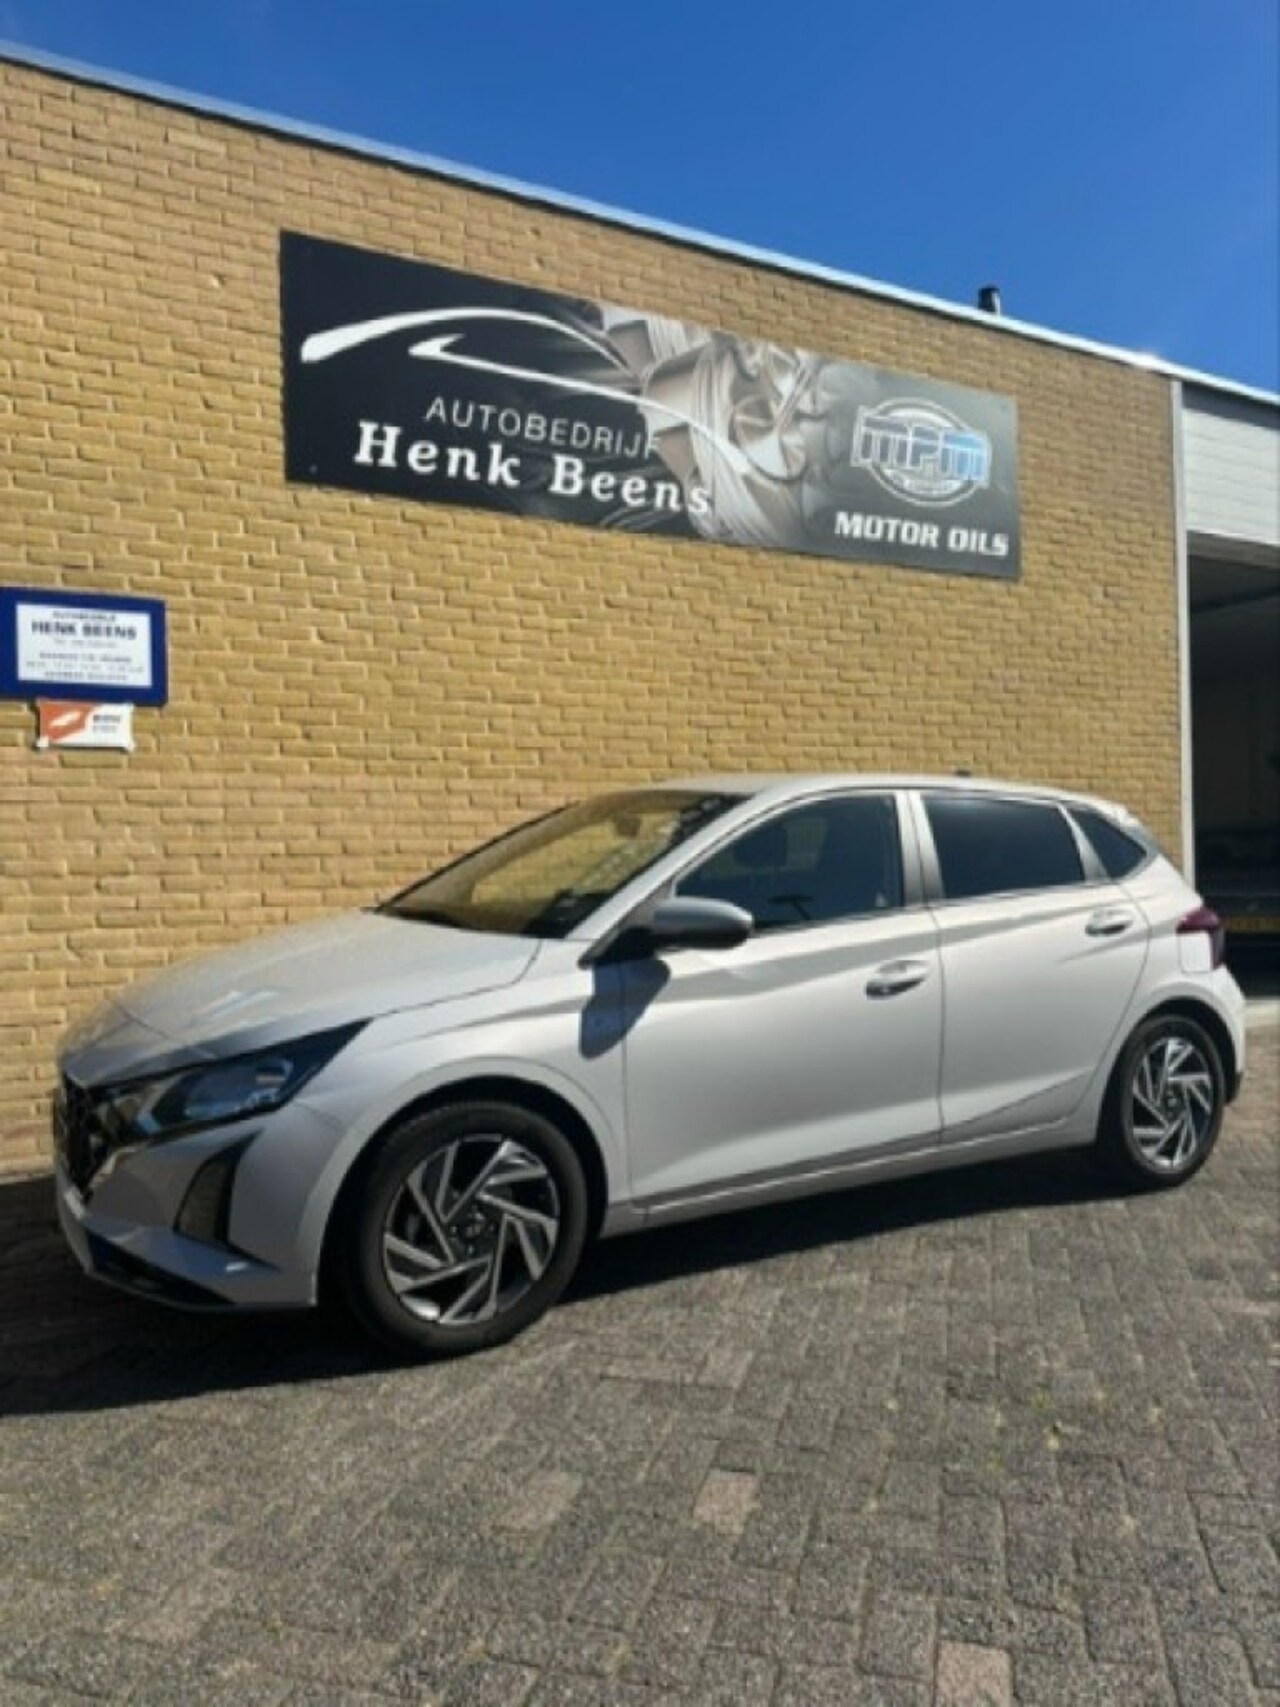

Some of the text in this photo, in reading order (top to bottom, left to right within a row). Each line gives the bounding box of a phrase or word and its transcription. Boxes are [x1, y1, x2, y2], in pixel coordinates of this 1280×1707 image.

[425, 396, 660, 459] AUTOBEDRIJF
[354, 419, 712, 514] Henk Beens
[834, 511, 1009, 557] MOTOR OILS
[31, 621, 76, 636] HENK
